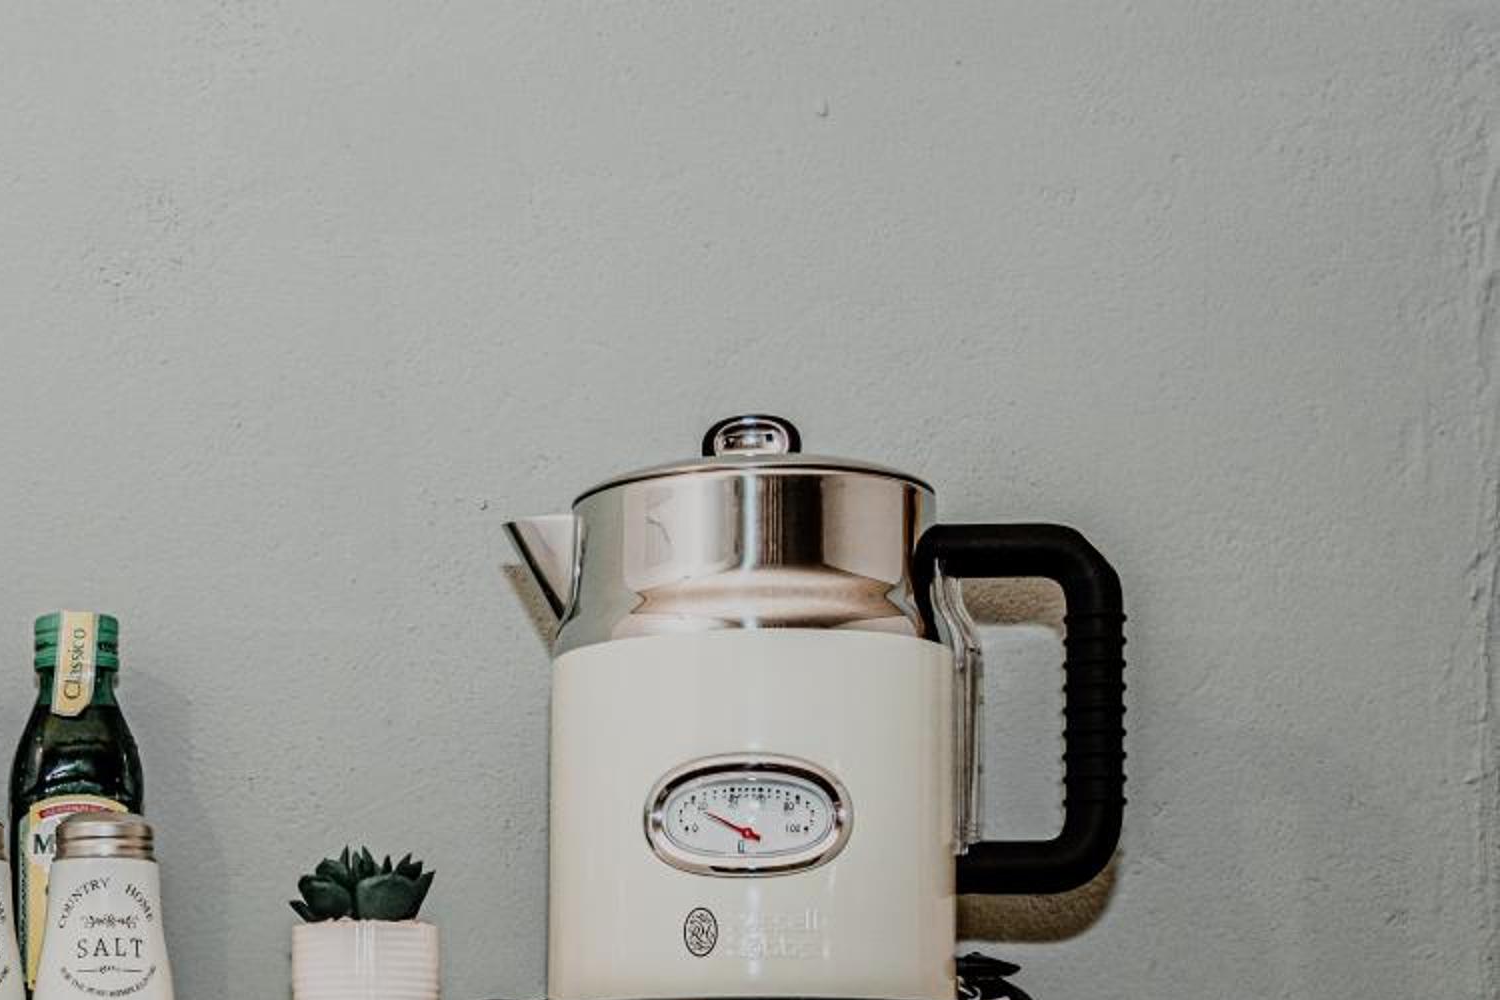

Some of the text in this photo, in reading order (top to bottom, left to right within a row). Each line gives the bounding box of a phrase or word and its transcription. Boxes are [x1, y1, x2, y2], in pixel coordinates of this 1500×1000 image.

[63, 627, 86, 700] Classico
[58, 877, 154, 929] COUNTRY HOME
[76, 937, 143, 959] SALT
